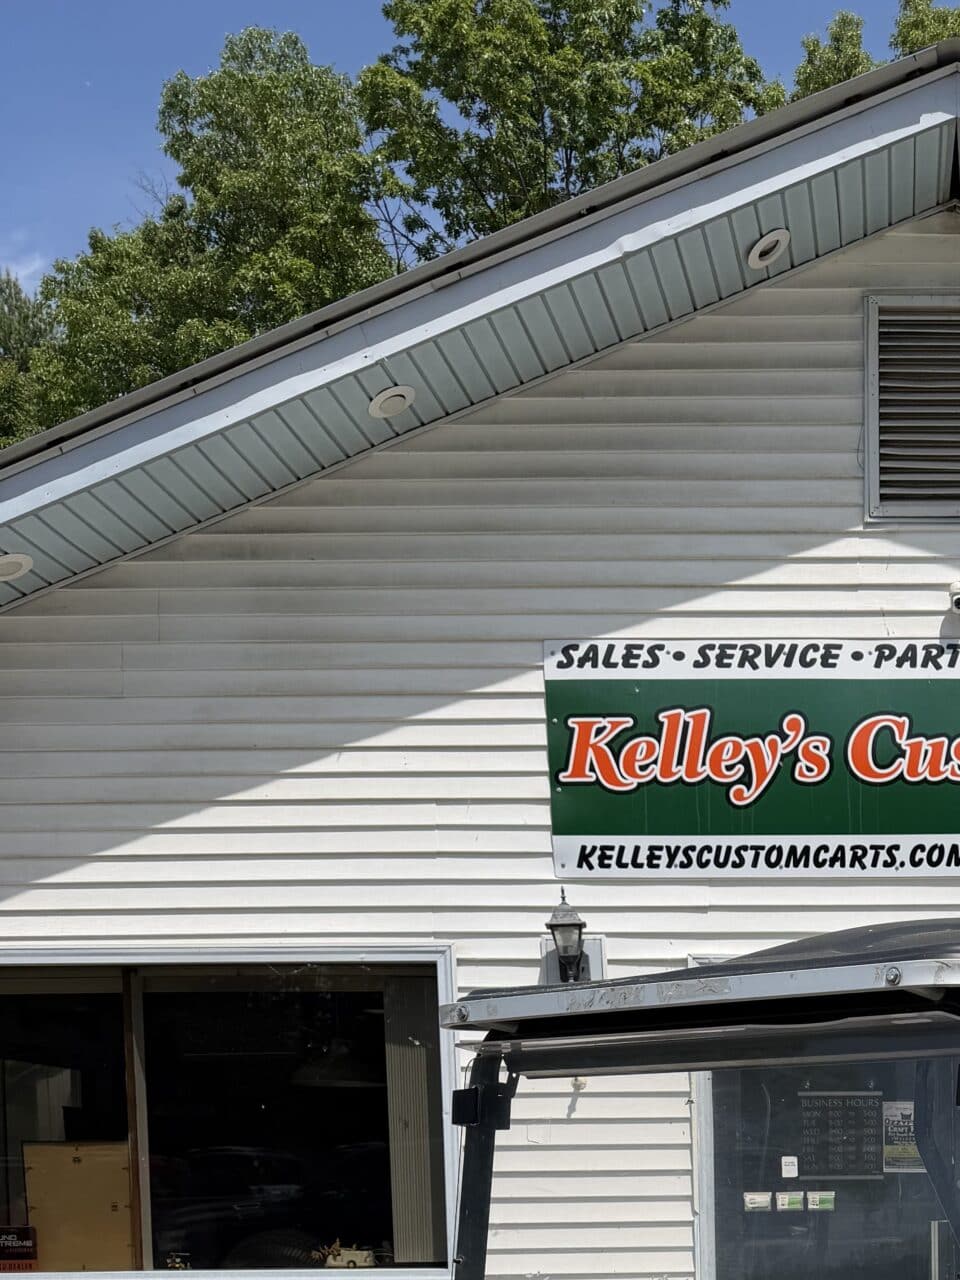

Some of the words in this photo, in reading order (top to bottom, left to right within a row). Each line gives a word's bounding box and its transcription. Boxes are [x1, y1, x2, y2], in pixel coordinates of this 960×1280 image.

[556, 643, 665, 669] SALES
[692, 643, 843, 671] SERVICE
[558, 708, 831, 806] Kelley's
[801, 1099, 843, 1108] BUSINESS
[846, 1098, 880, 1108] HOURS
